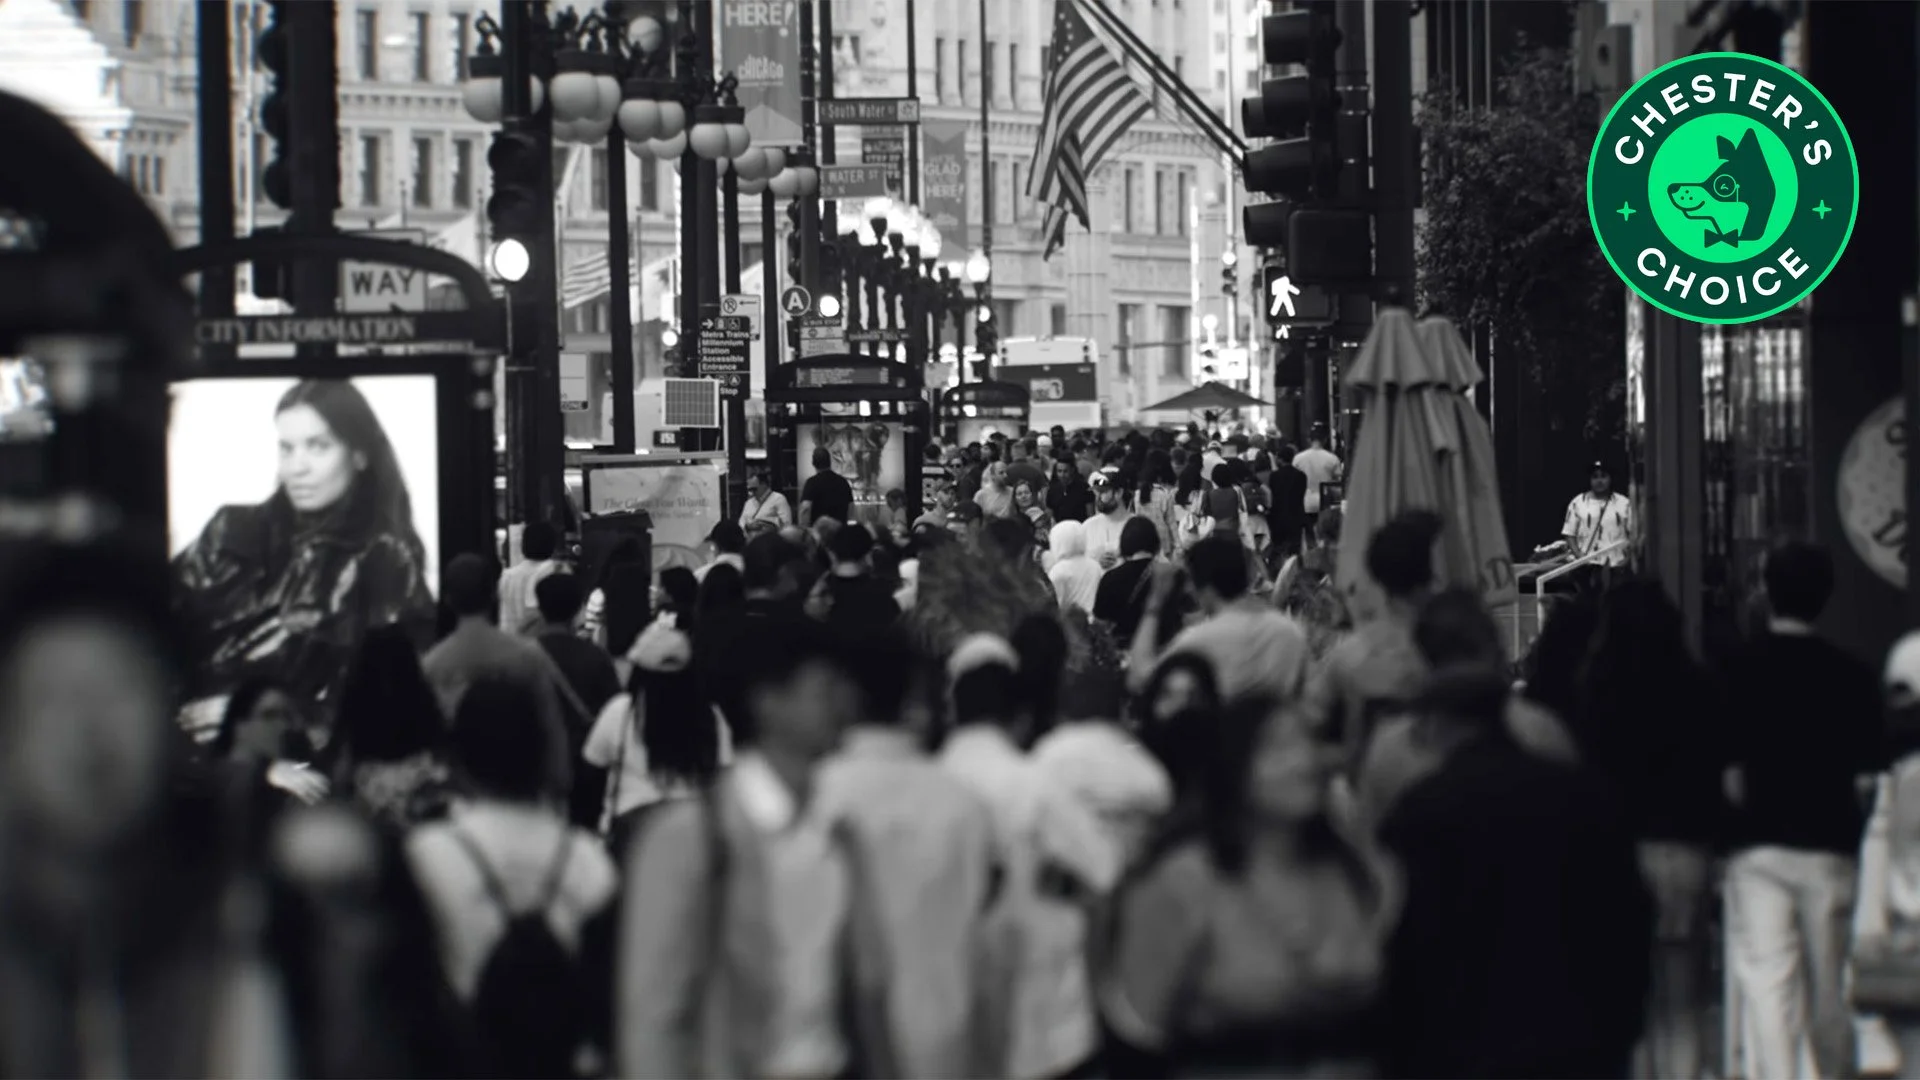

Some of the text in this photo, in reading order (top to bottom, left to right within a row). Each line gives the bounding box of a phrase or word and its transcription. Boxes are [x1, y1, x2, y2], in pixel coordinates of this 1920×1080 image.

[725, 1, 795, 37] HERE!
[828, 103, 856, 119] South
[858, 102, 886, 119] Water
[828, 169, 864, 184] WATER
[868, 168, 879, 180] ST
[925, 162, 961, 176] GLAD
[351, 268, 417, 296] WAY
[787, 291, 805, 311] A
[196, 317, 416, 344] CITY INFORMATION
[701, 330, 724, 339] Metra
[726, 330, 750, 339] Trains
[701, 339, 744, 347] Millennium
[701, 347, 731, 355] Station
[702, 355, 744, 363] Accessible
[701, 363, 738, 371] Entrance
[720, 387, 739, 396] Stop
